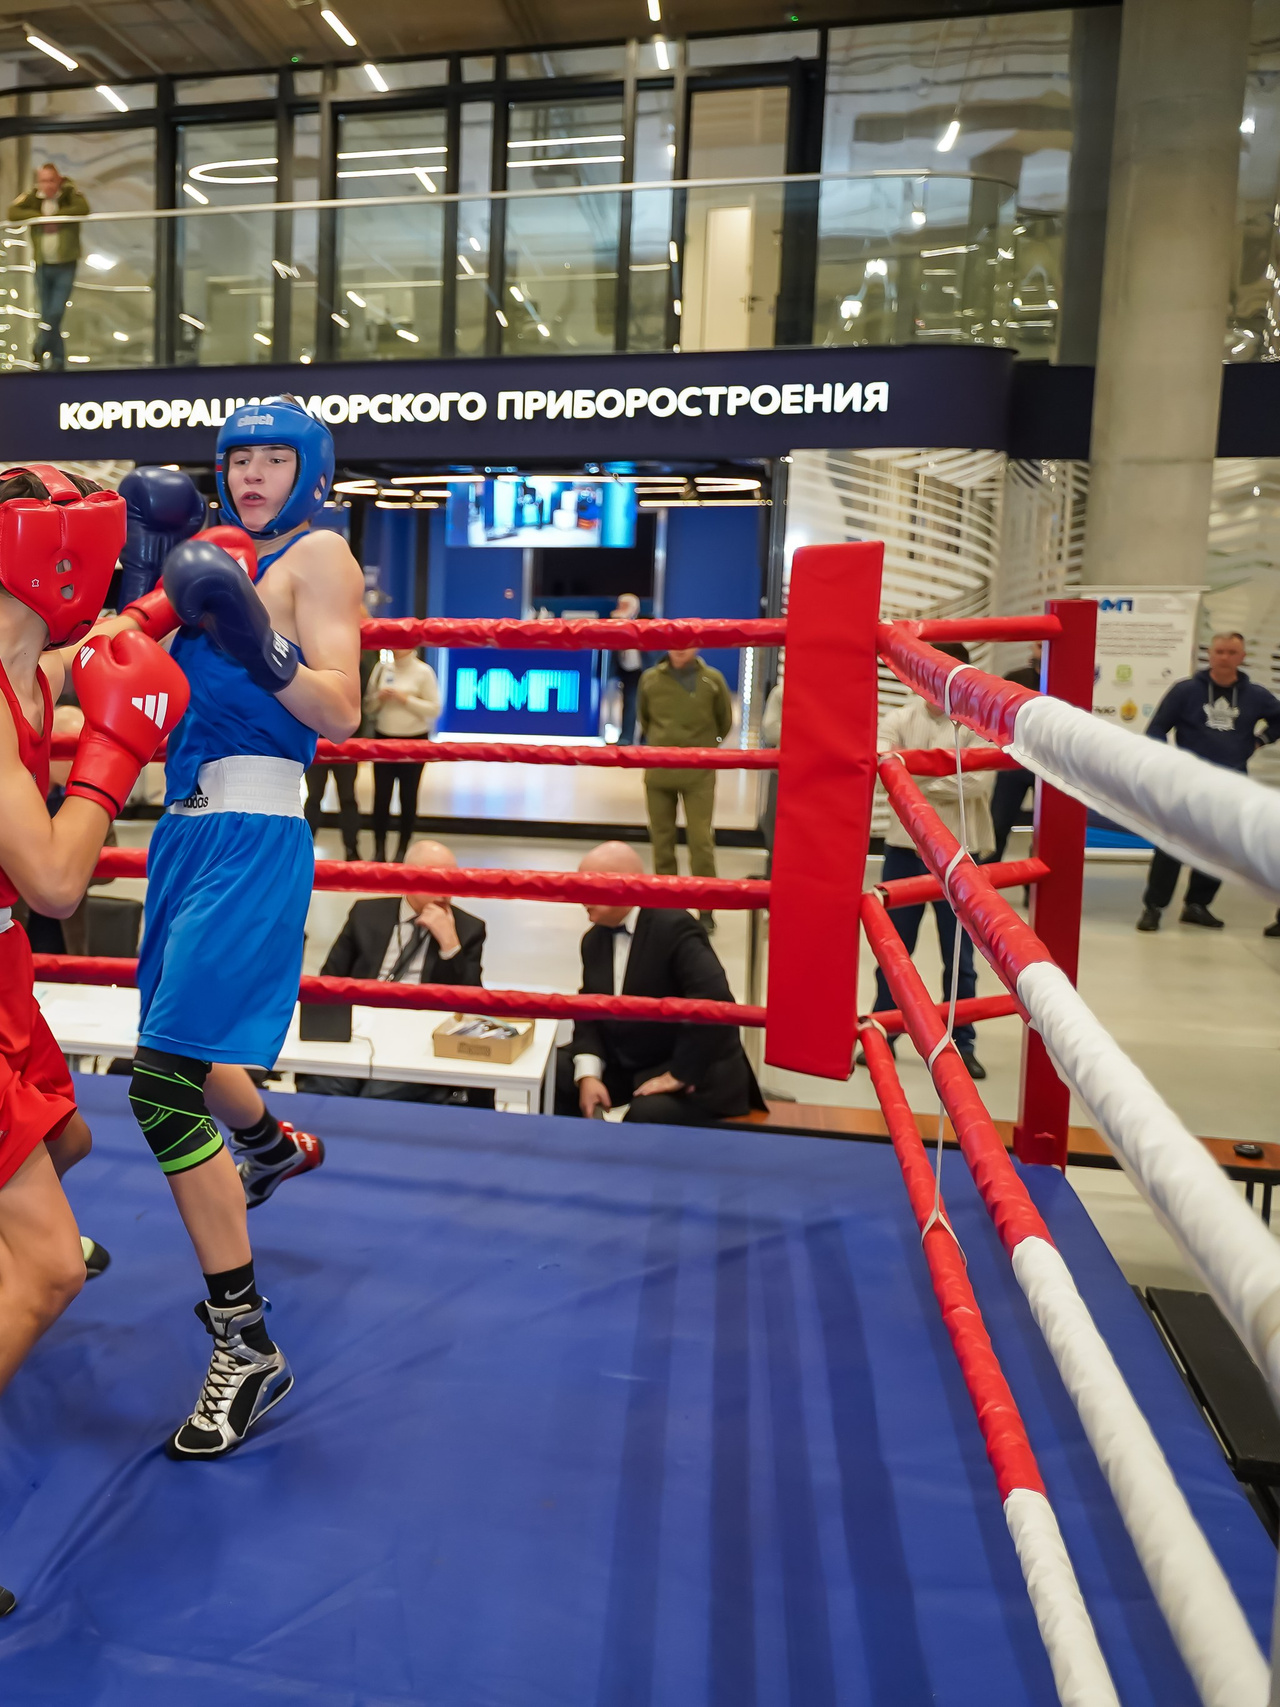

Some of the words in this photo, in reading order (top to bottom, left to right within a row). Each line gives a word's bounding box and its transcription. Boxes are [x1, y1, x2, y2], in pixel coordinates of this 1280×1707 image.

[59, 396, 283, 430] КОРПОРАЦ
[497, 381, 890, 421] ПРИБОРОСТРОЕНИЯ
[455, 667, 580, 713] КМП
